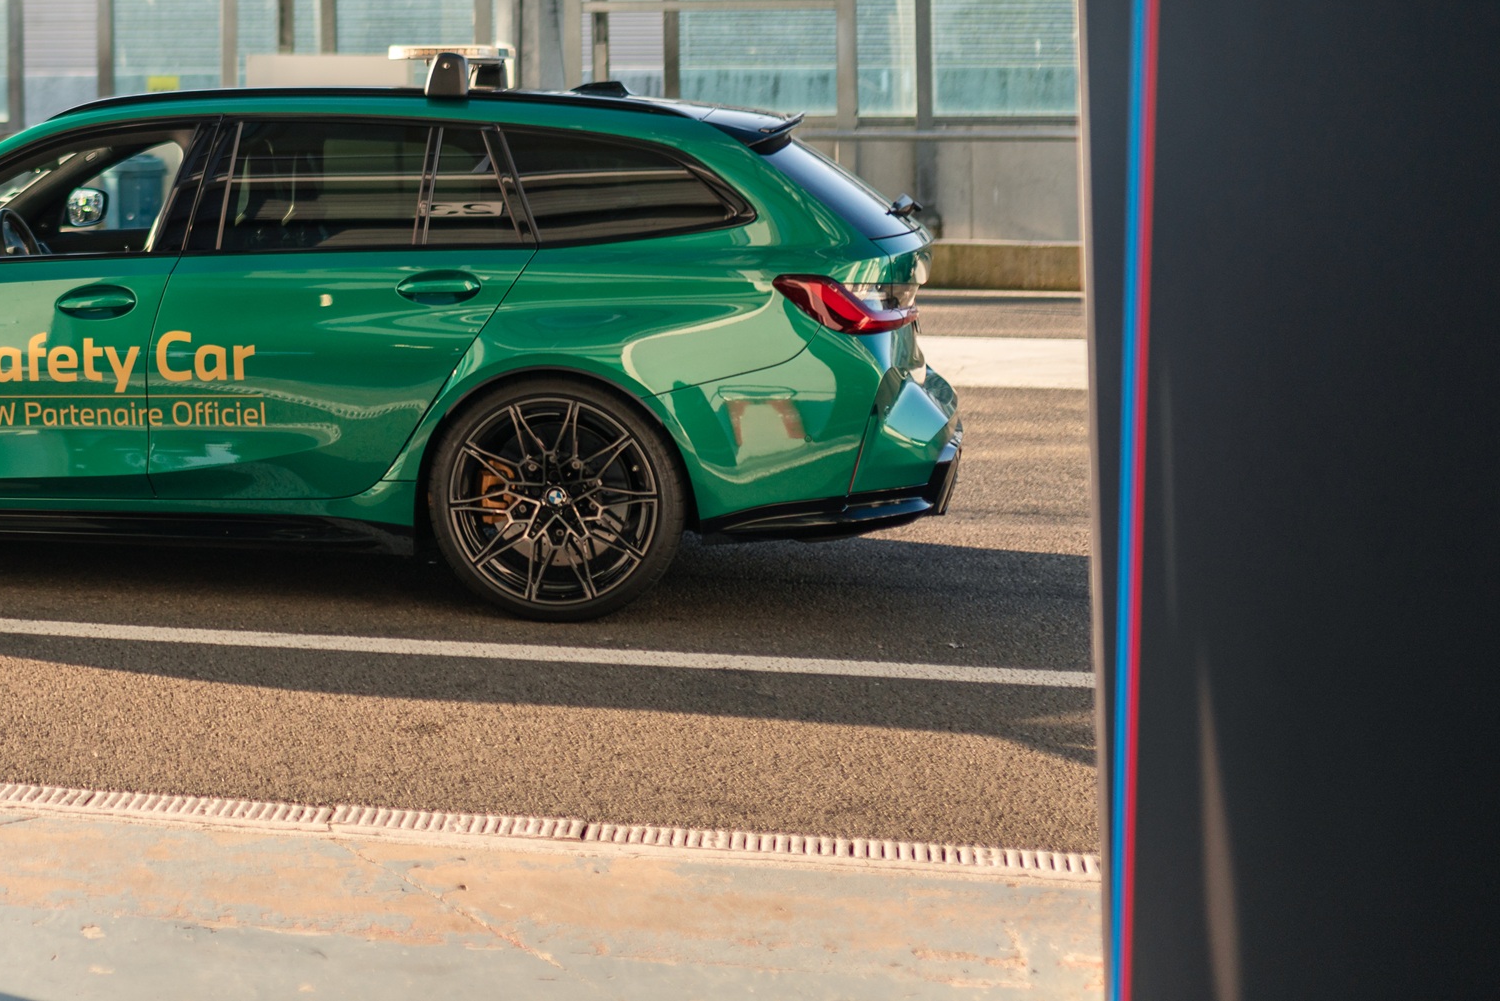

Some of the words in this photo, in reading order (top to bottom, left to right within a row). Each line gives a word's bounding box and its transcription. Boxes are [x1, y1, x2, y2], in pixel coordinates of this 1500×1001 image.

[155, 330, 256, 382] Car
[24, 401, 164, 427] Partenaire
[171, 401, 267, 427] Officiel
